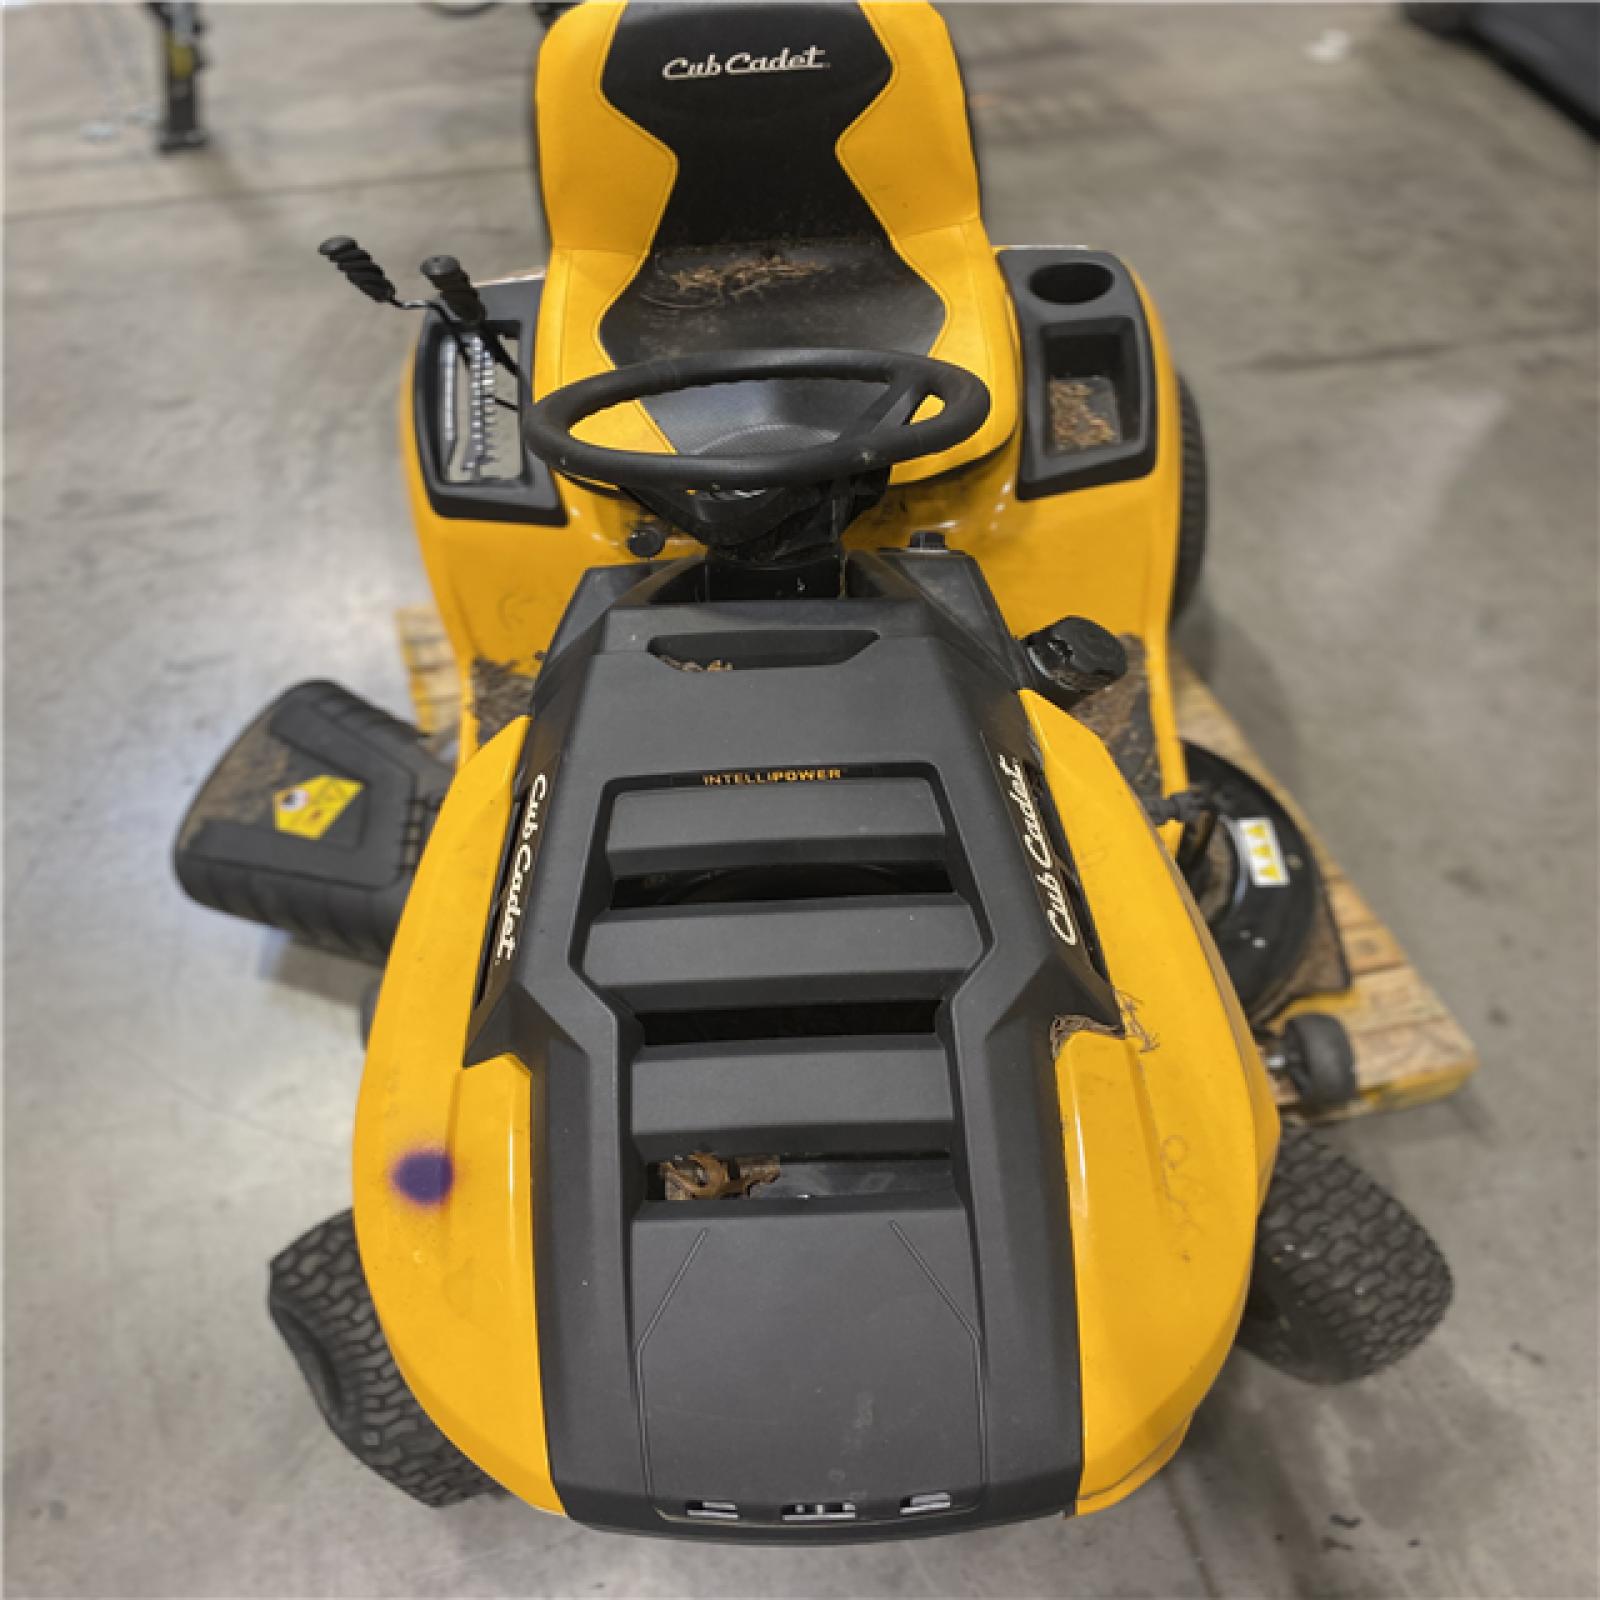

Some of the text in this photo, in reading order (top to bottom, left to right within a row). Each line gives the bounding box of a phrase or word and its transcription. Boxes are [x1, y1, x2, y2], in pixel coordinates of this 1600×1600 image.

[662, 45, 831, 80] Cub Cadet
[702, 768, 842, 786] INTELLIPOWER
[496, 773, 547, 961] Cub Cadet
[997, 753, 1077, 946] Cub Cadet
